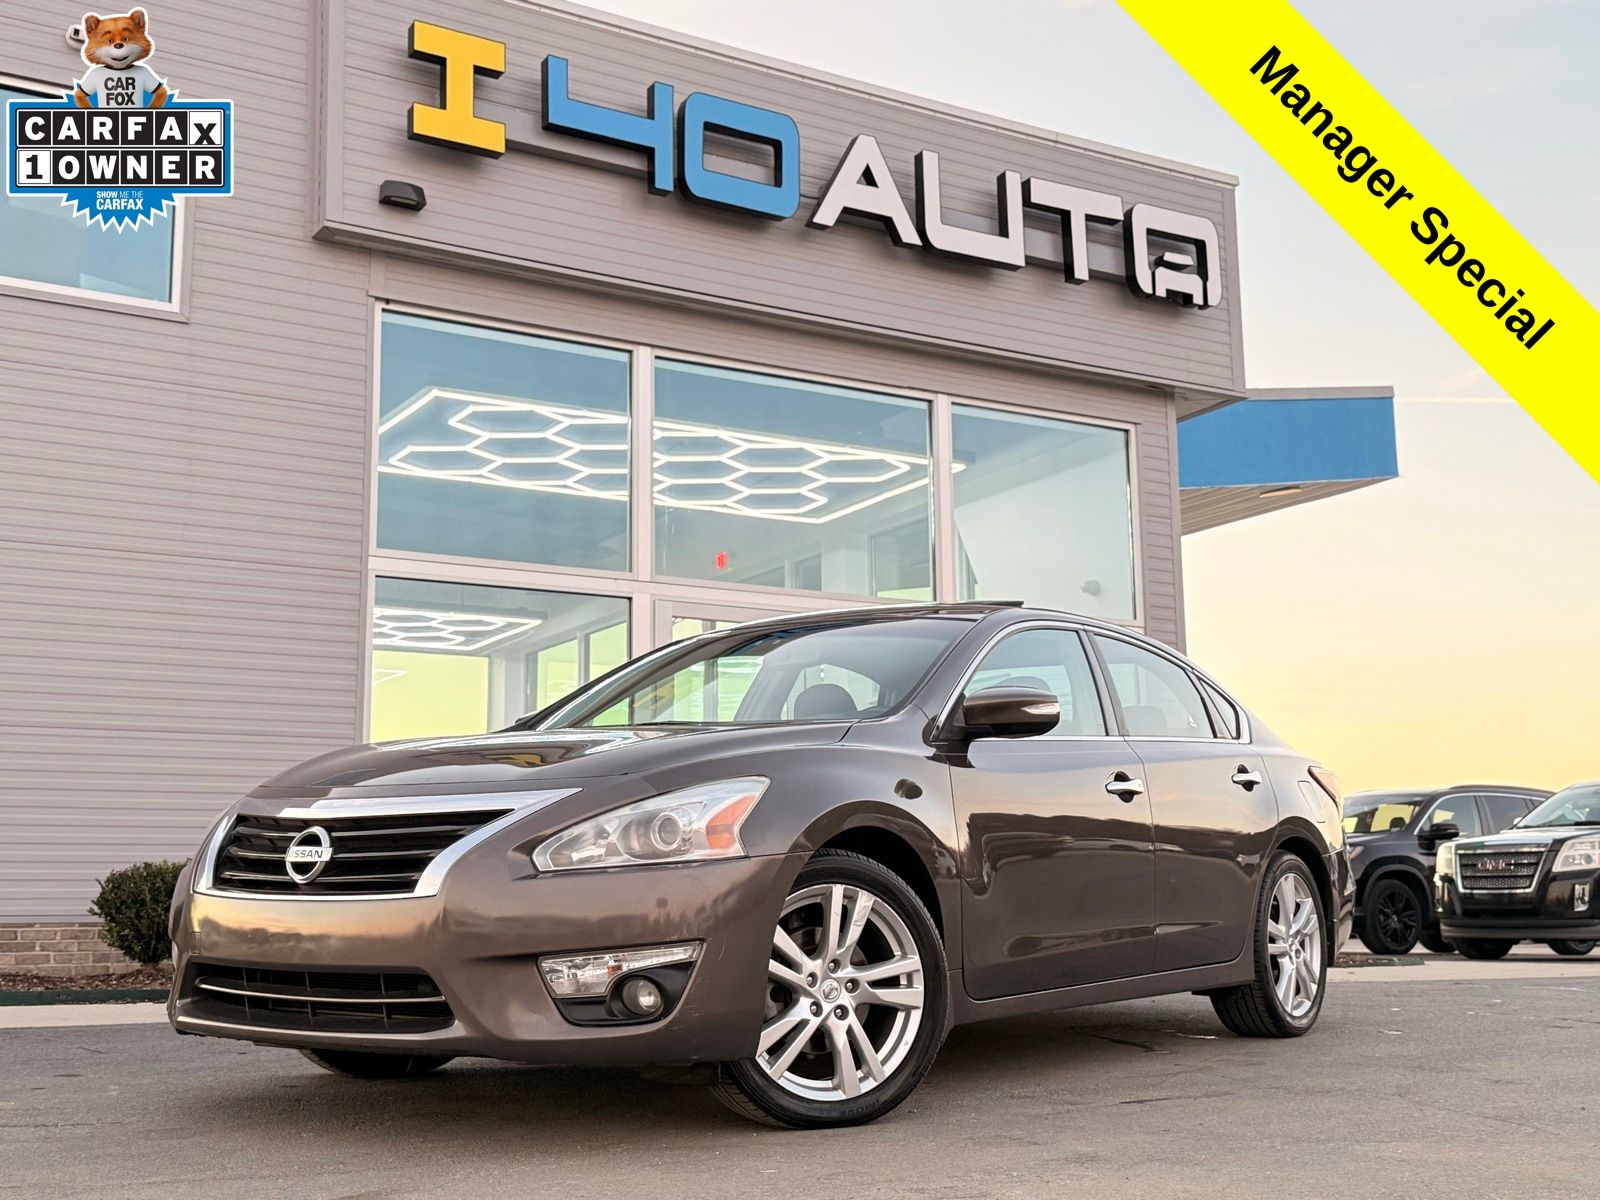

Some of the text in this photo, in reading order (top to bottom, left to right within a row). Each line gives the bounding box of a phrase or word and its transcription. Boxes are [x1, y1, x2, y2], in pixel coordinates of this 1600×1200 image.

[408, 20, 1223, 308] I 40 AUTO
